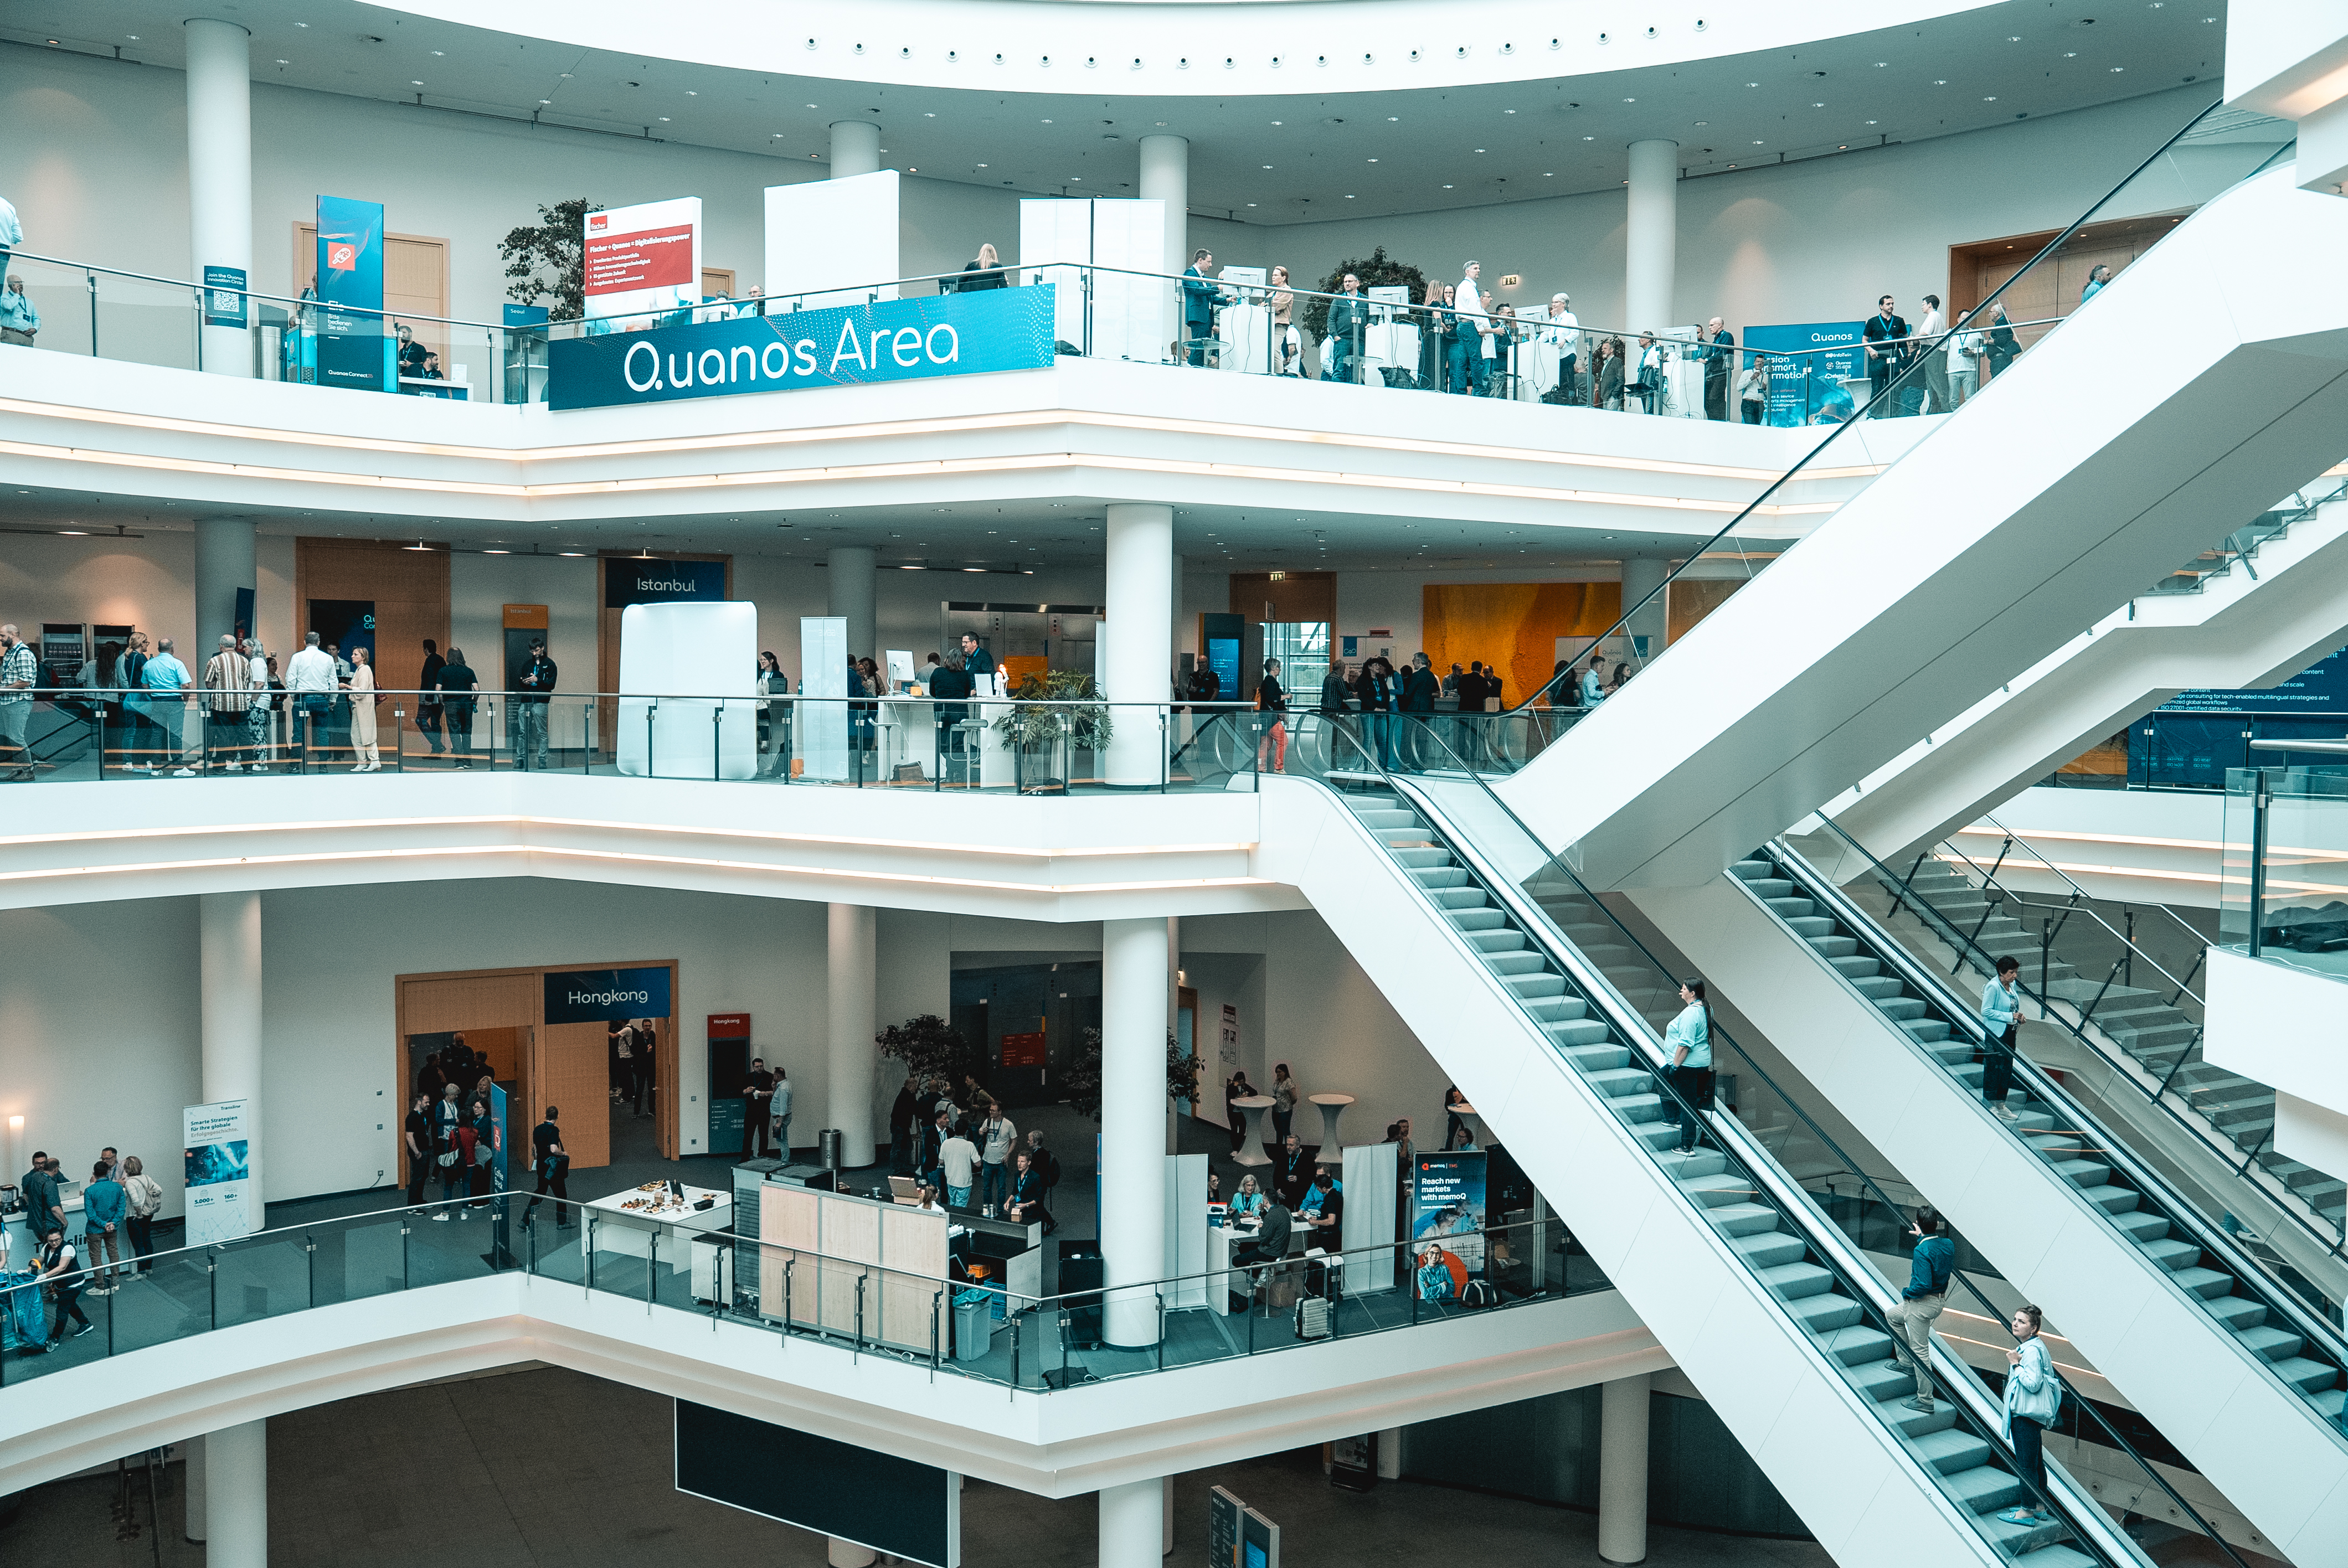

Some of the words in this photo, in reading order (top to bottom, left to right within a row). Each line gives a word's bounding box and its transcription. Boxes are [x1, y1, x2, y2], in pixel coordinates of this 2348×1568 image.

[590, 245, 607, 253] Fischer
[612, 241, 630, 251] Quanos
[635, 234, 690, 247] Digitalisierungspower
[1811, 333, 1853, 342] Quanos
[624, 338, 817, 392] Quanos
[830, 317, 959, 374] Area
[637, 577, 696, 592] Istanbul
[569, 989, 648, 1005] Hongkong
[191, 1127, 239, 1138] Erfolgsgeschichte.
